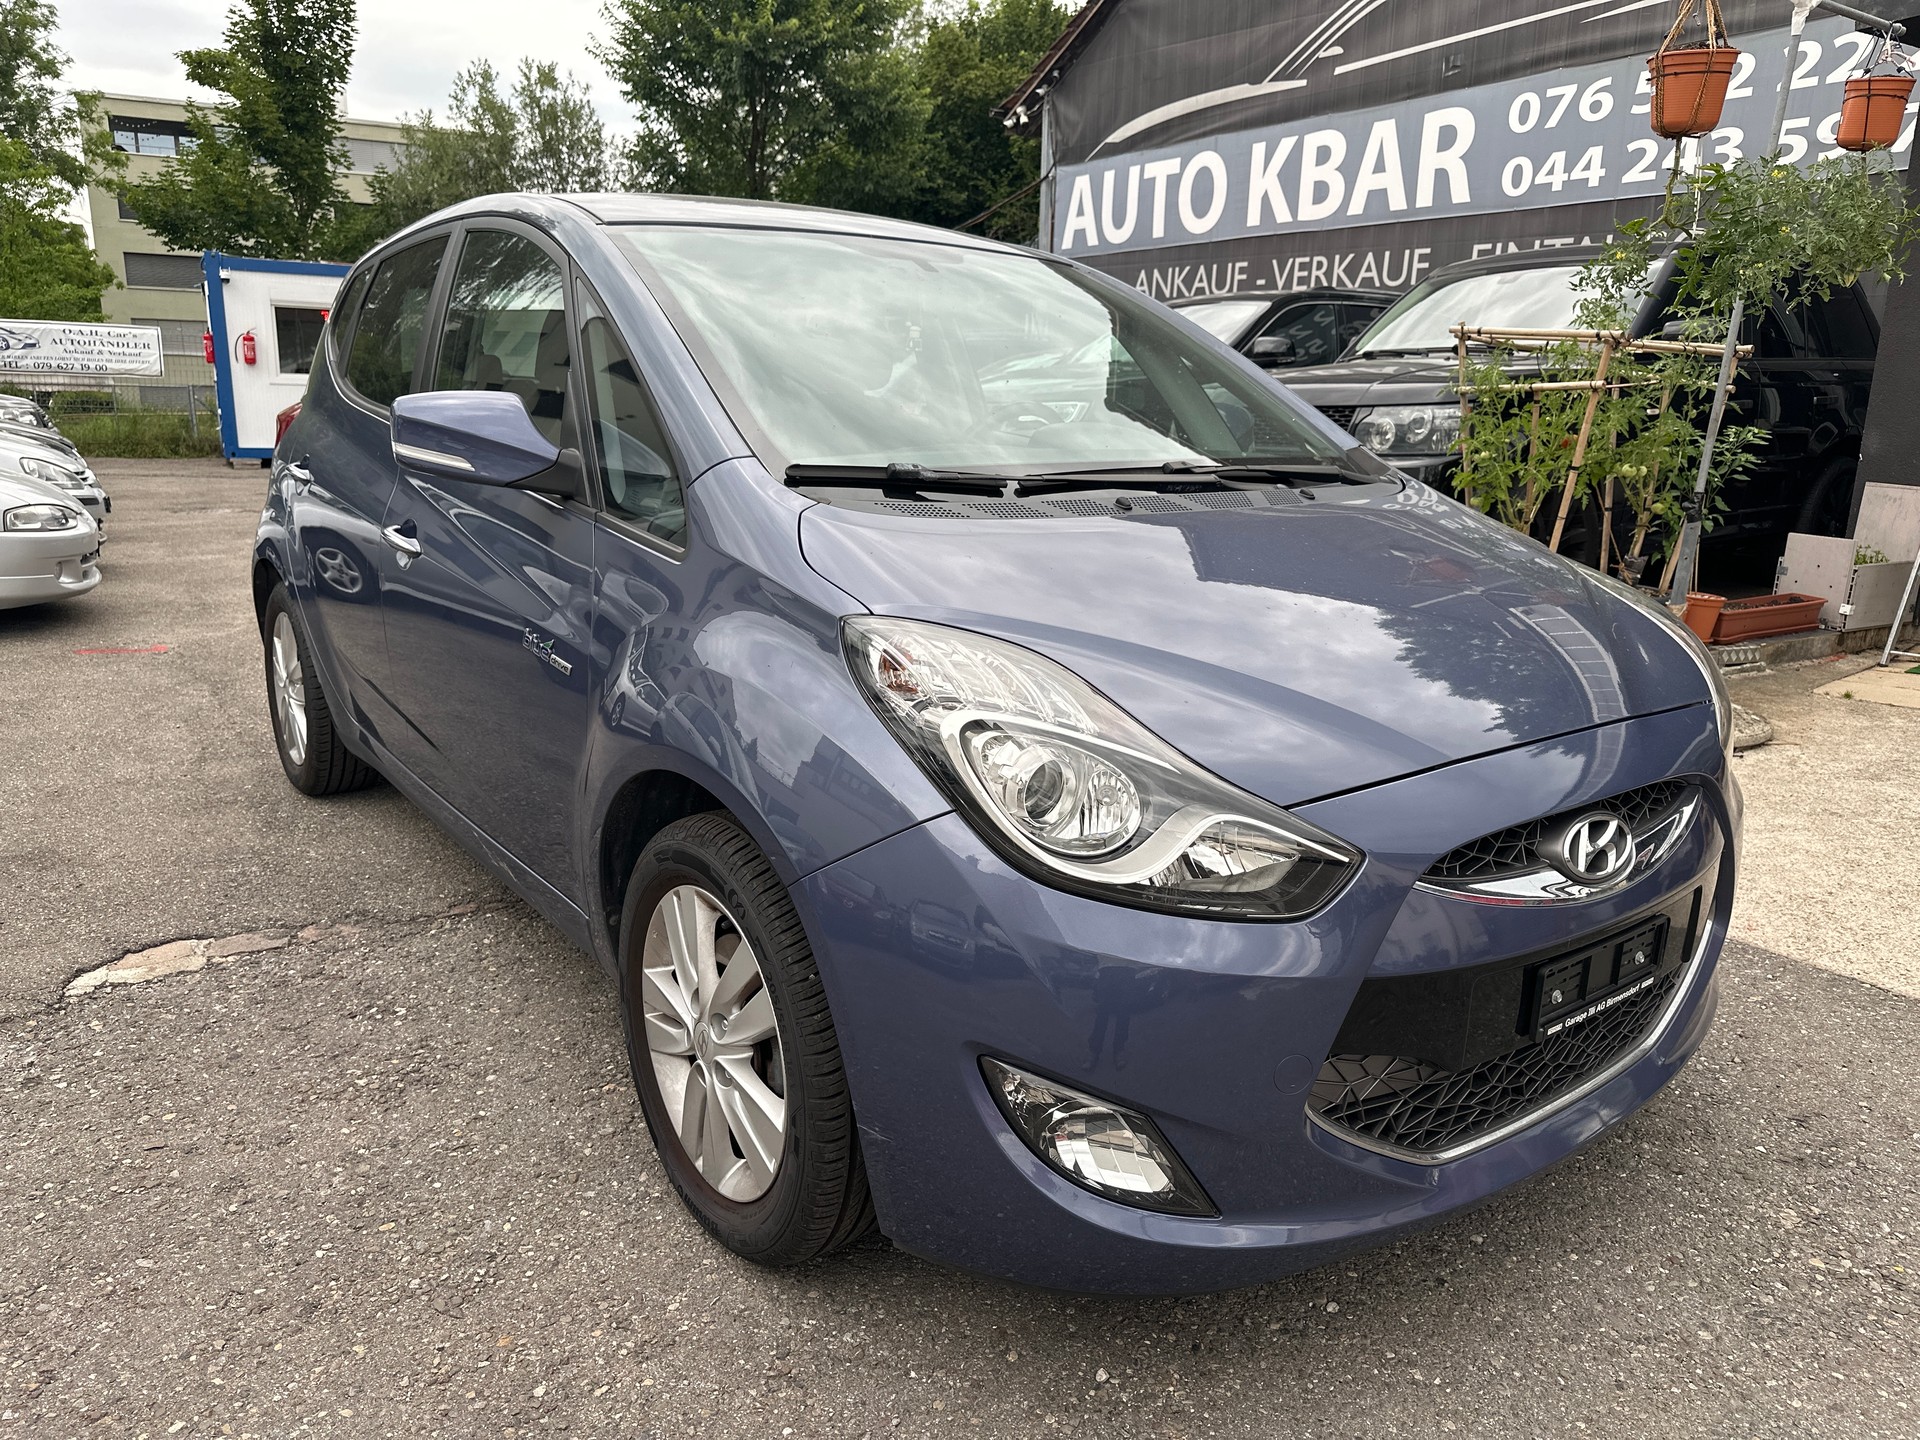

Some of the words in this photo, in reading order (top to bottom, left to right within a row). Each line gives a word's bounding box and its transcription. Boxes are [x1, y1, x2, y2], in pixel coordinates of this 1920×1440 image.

[1508, 76, 1615, 134] 076
[1061, 150, 1229, 250] AUTO
[1246, 106, 1476, 227] KBAR
[1501, 145, 1606, 197] 044
[1134, 261, 1248, 299] ANKAUF
[1272, 248, 1432, 291] VERKAUF
[33, 361, 52, 370] 079
[57, 362, 75, 371] 627
[80, 363, 91, 371] 19
[94, 364, 108, 372] 00
[50, 338, 151, 350] AUTOHÄNDLER
[1565, 1011, 1588, 1028] Garage
[1595, 1001, 1606, 1013] AG
[1606, 983, 1640, 1007] Birmensdorf
